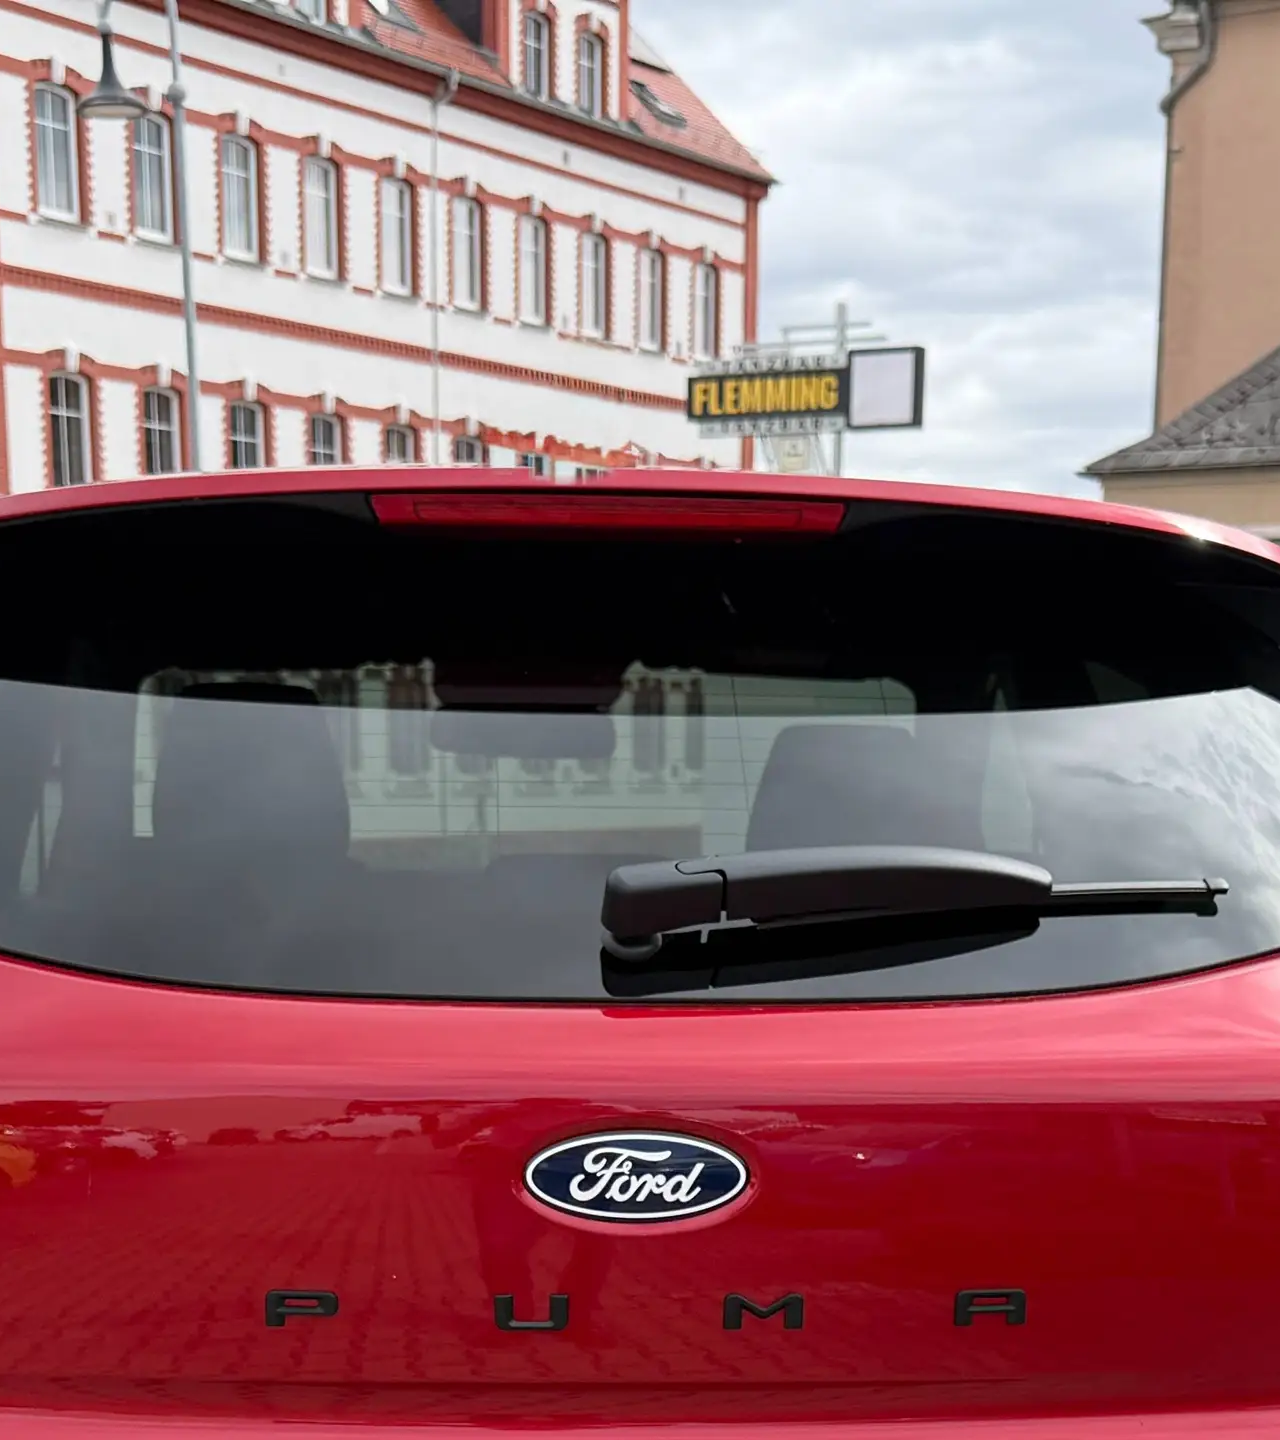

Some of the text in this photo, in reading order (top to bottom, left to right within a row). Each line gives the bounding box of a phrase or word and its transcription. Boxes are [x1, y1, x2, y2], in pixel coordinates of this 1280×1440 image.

[692, 374, 840, 417] FLEMMING
[568, 1147, 706, 1204] Ford
[264, 1288, 1028, 1331] PUMA
